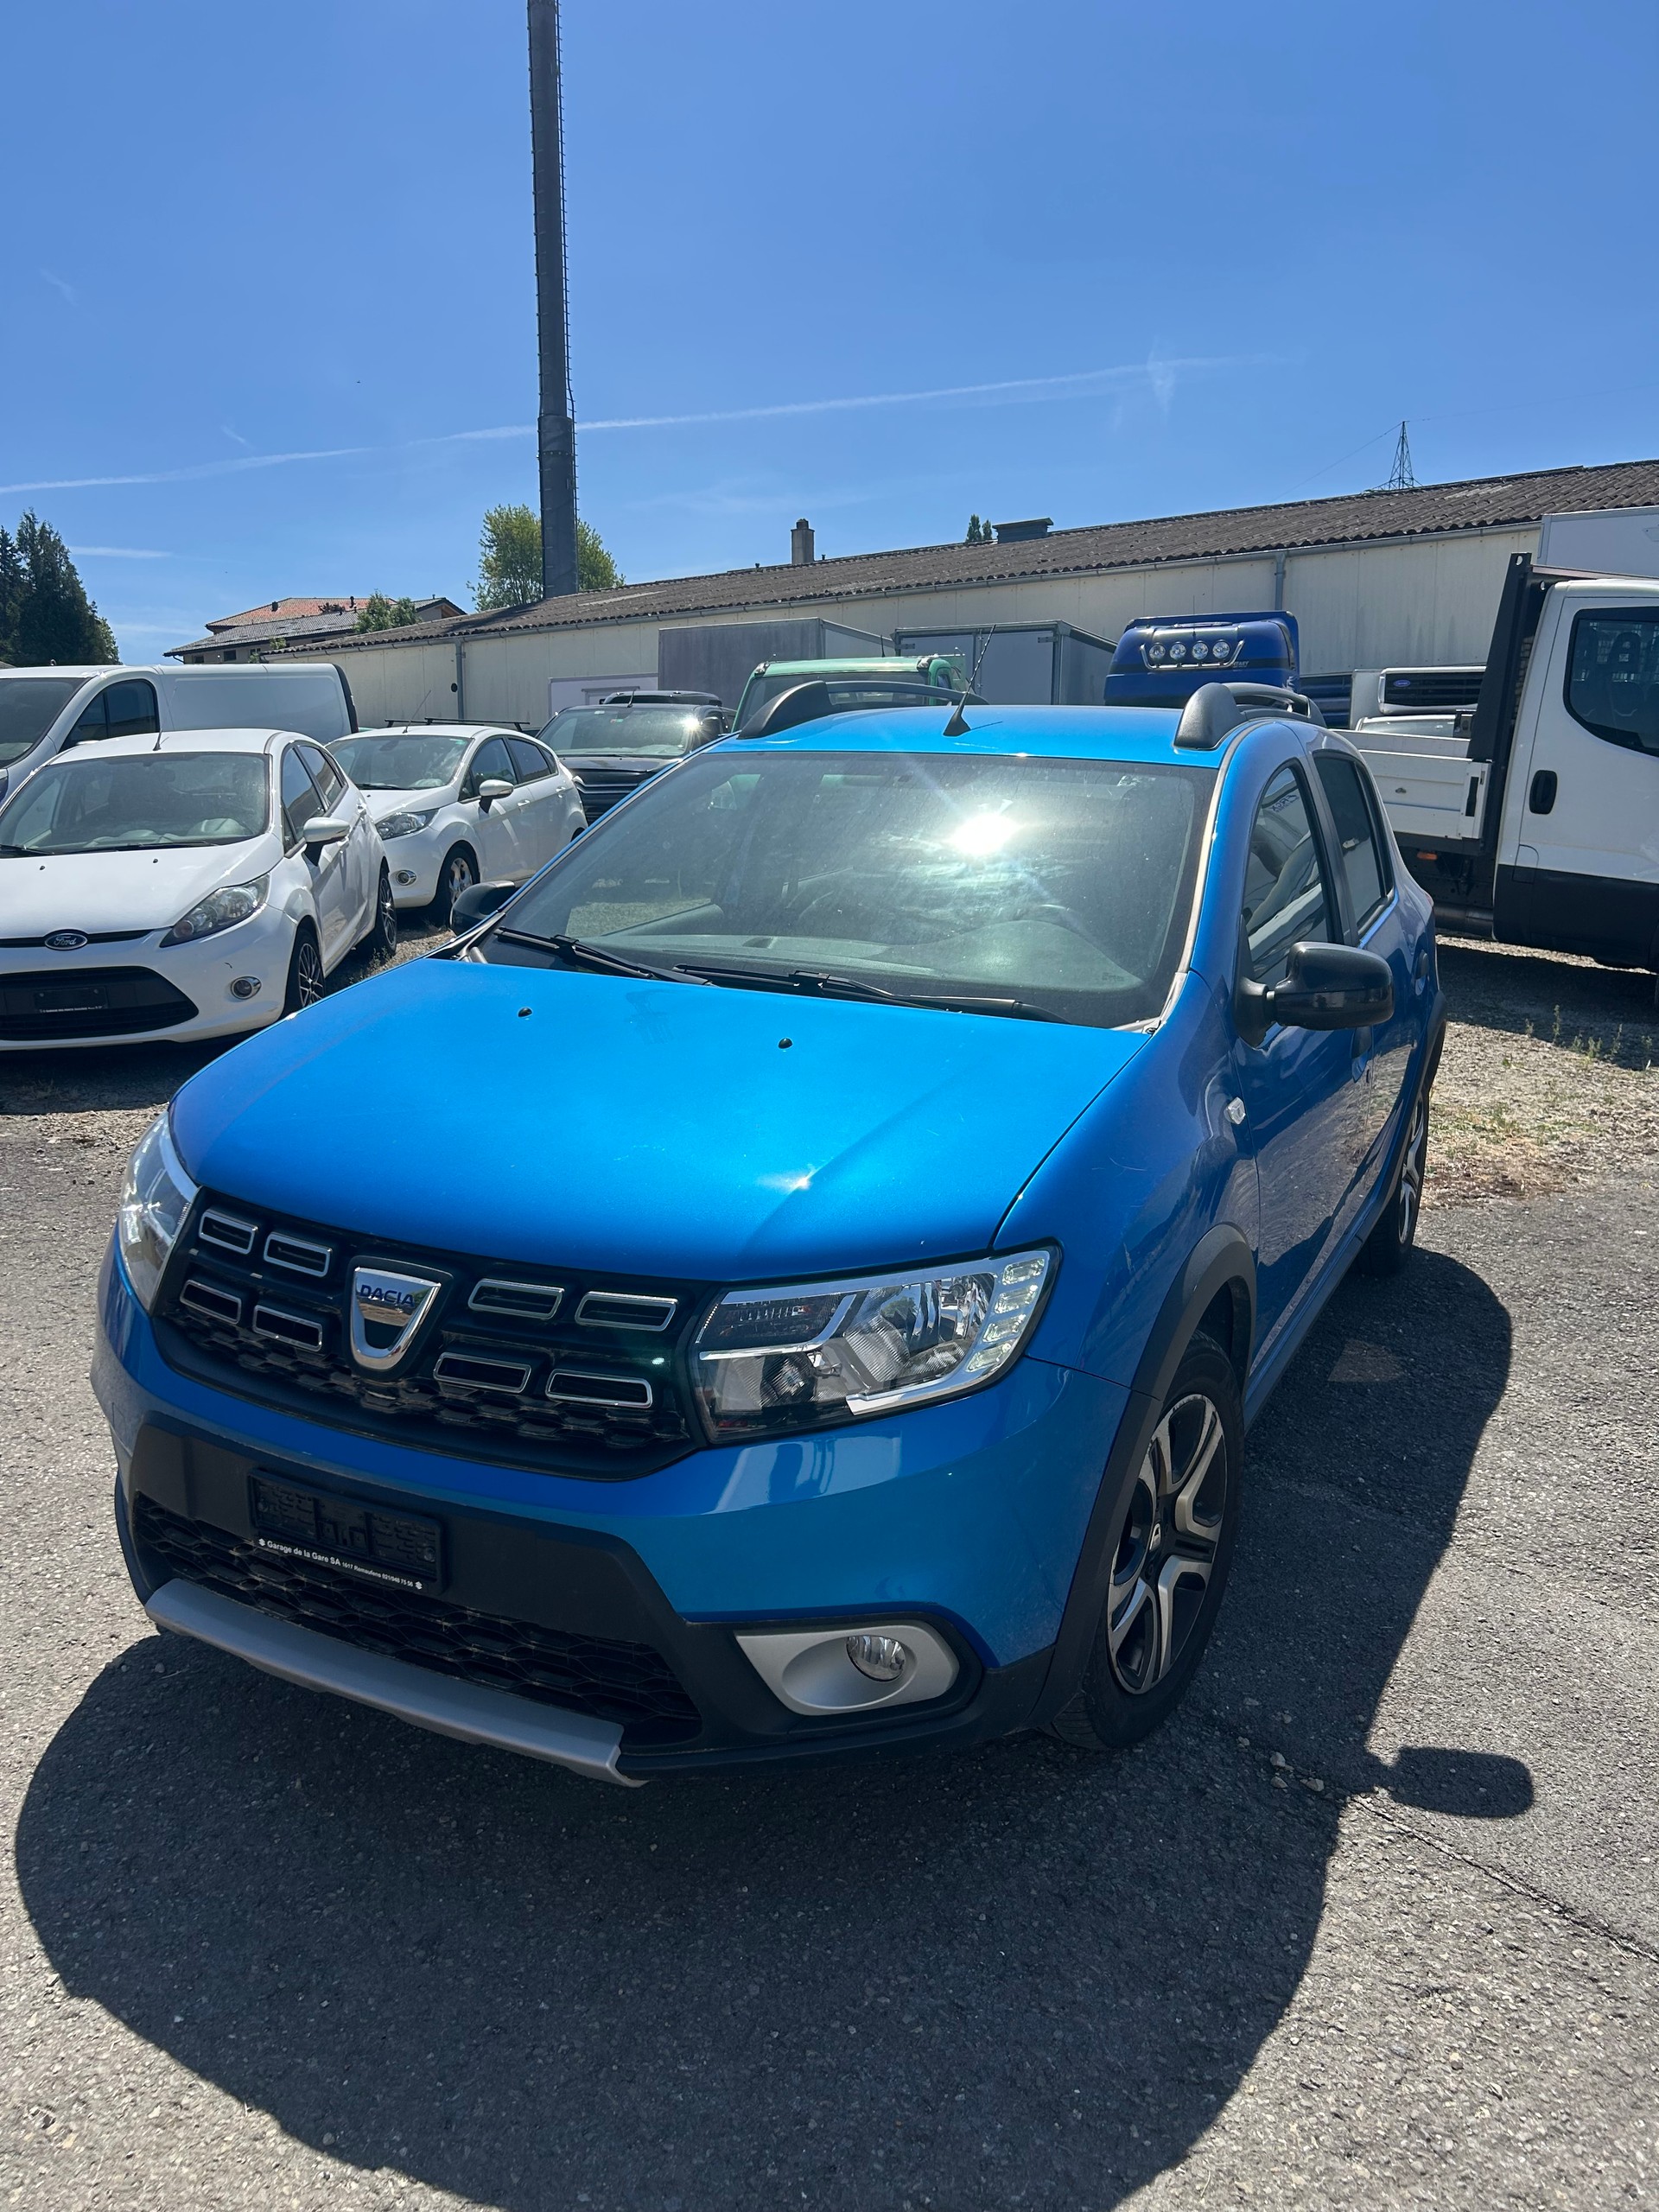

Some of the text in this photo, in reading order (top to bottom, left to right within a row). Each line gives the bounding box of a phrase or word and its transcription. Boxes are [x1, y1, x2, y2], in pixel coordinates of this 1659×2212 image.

[54, 936, 77, 946] Ford
[360, 1284, 415, 1307] DACIA
[267, 1540, 293, 1554] Garage
[294, 1548, 302, 1556] de
[303, 1549, 311, 1558] la
[312, 1552, 329, 1563] Gare
[330, 1556, 341, 1566] SA
